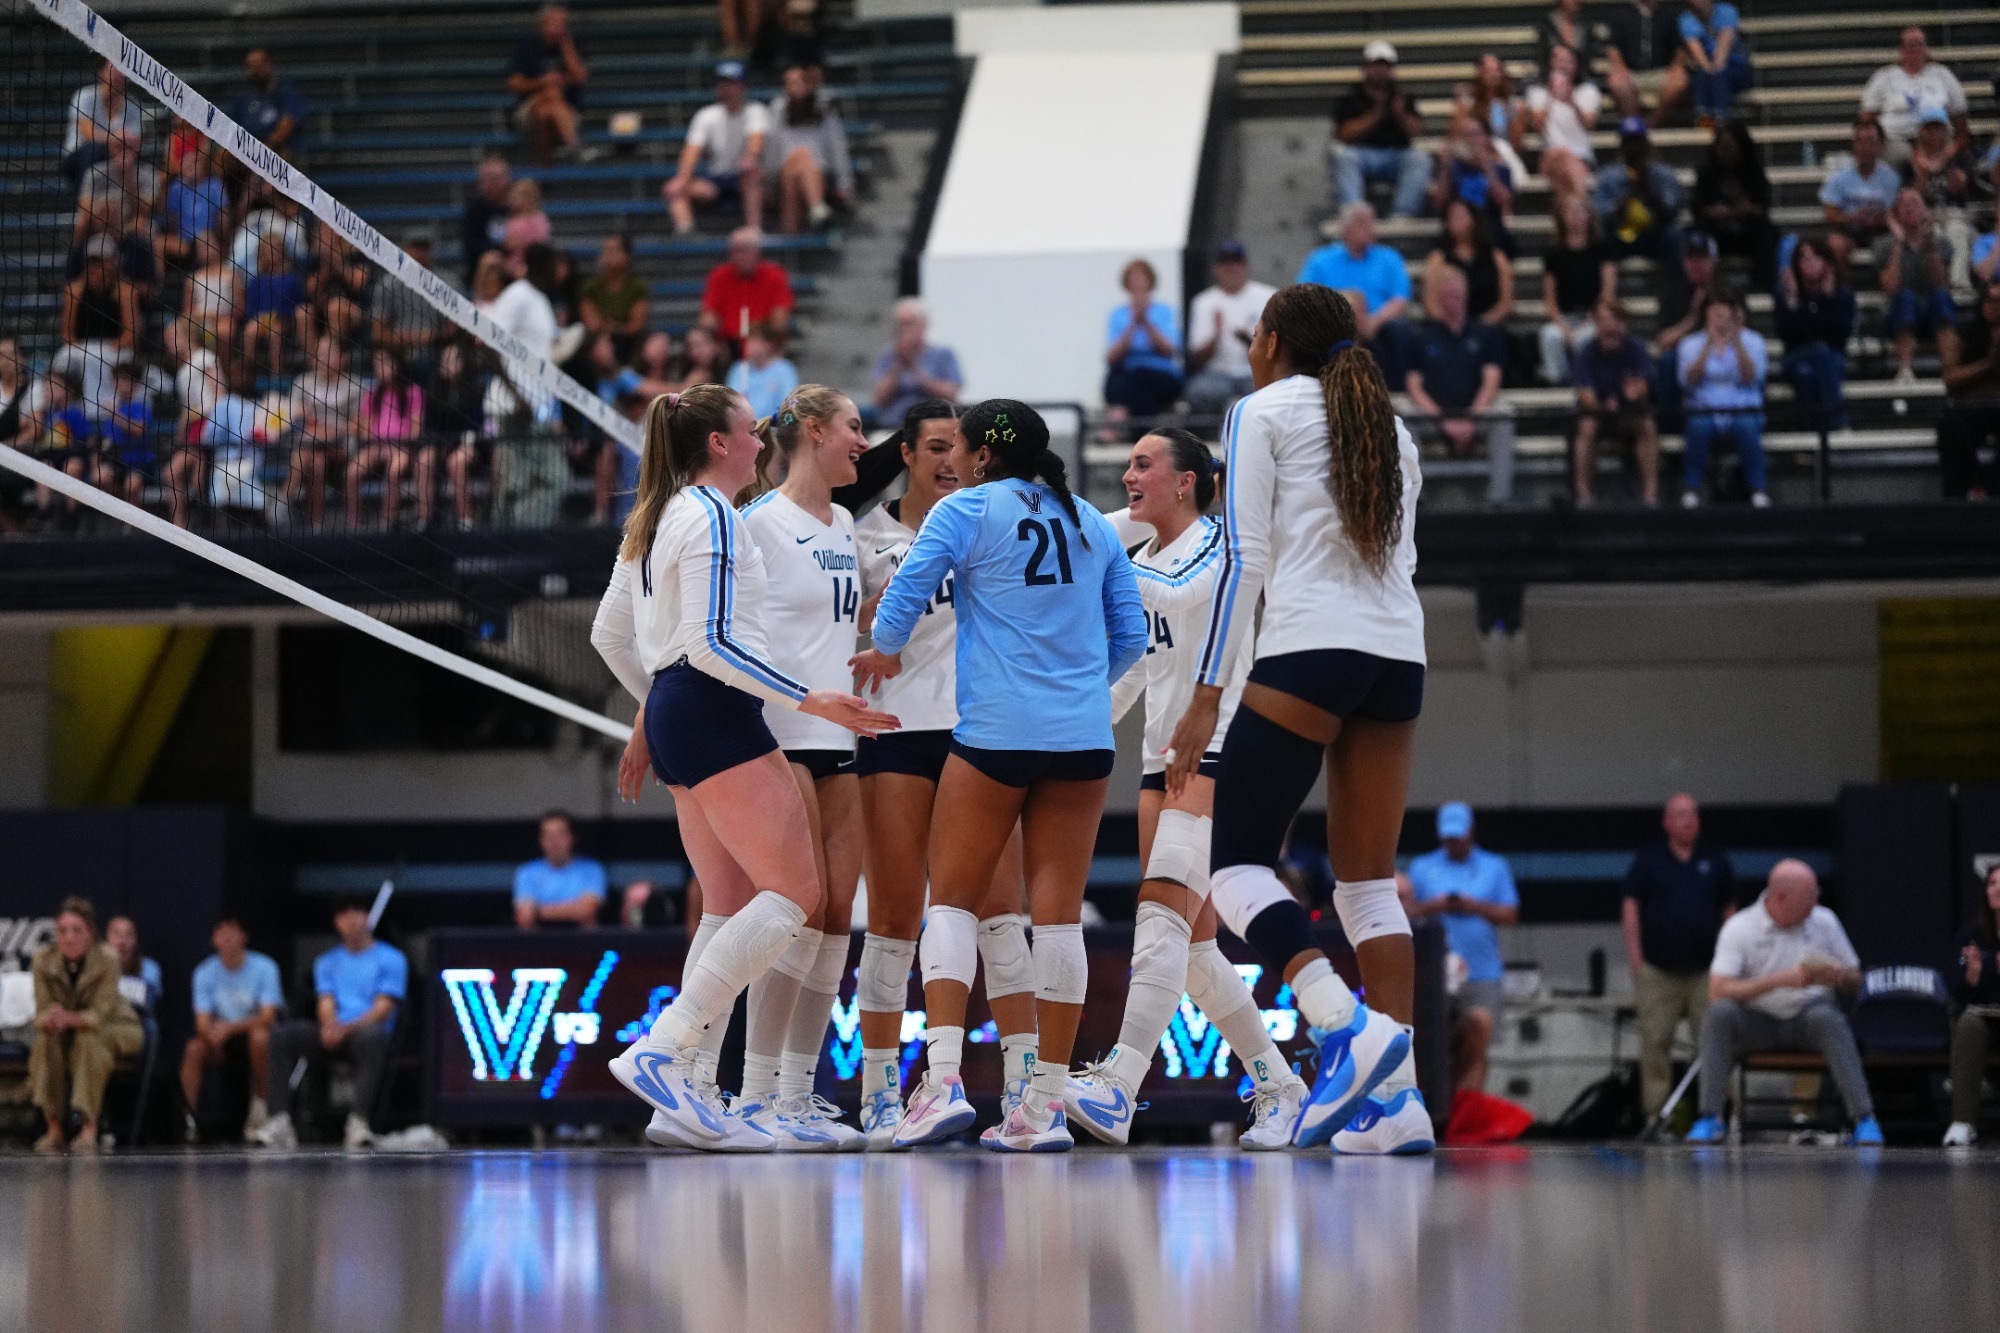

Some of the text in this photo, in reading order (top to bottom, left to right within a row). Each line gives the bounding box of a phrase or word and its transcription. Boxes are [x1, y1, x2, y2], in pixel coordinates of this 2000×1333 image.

[121, 36, 184, 109] VILLANOVA
[236, 125, 290, 189] VILLANOVA
[333, 199, 381, 256] VILLANOVA
[812, 549, 858, 571] Villano
[1017, 517, 1075, 587] 21
[832, 576, 859, 623] 14
[442, 968, 568, 1081] V
